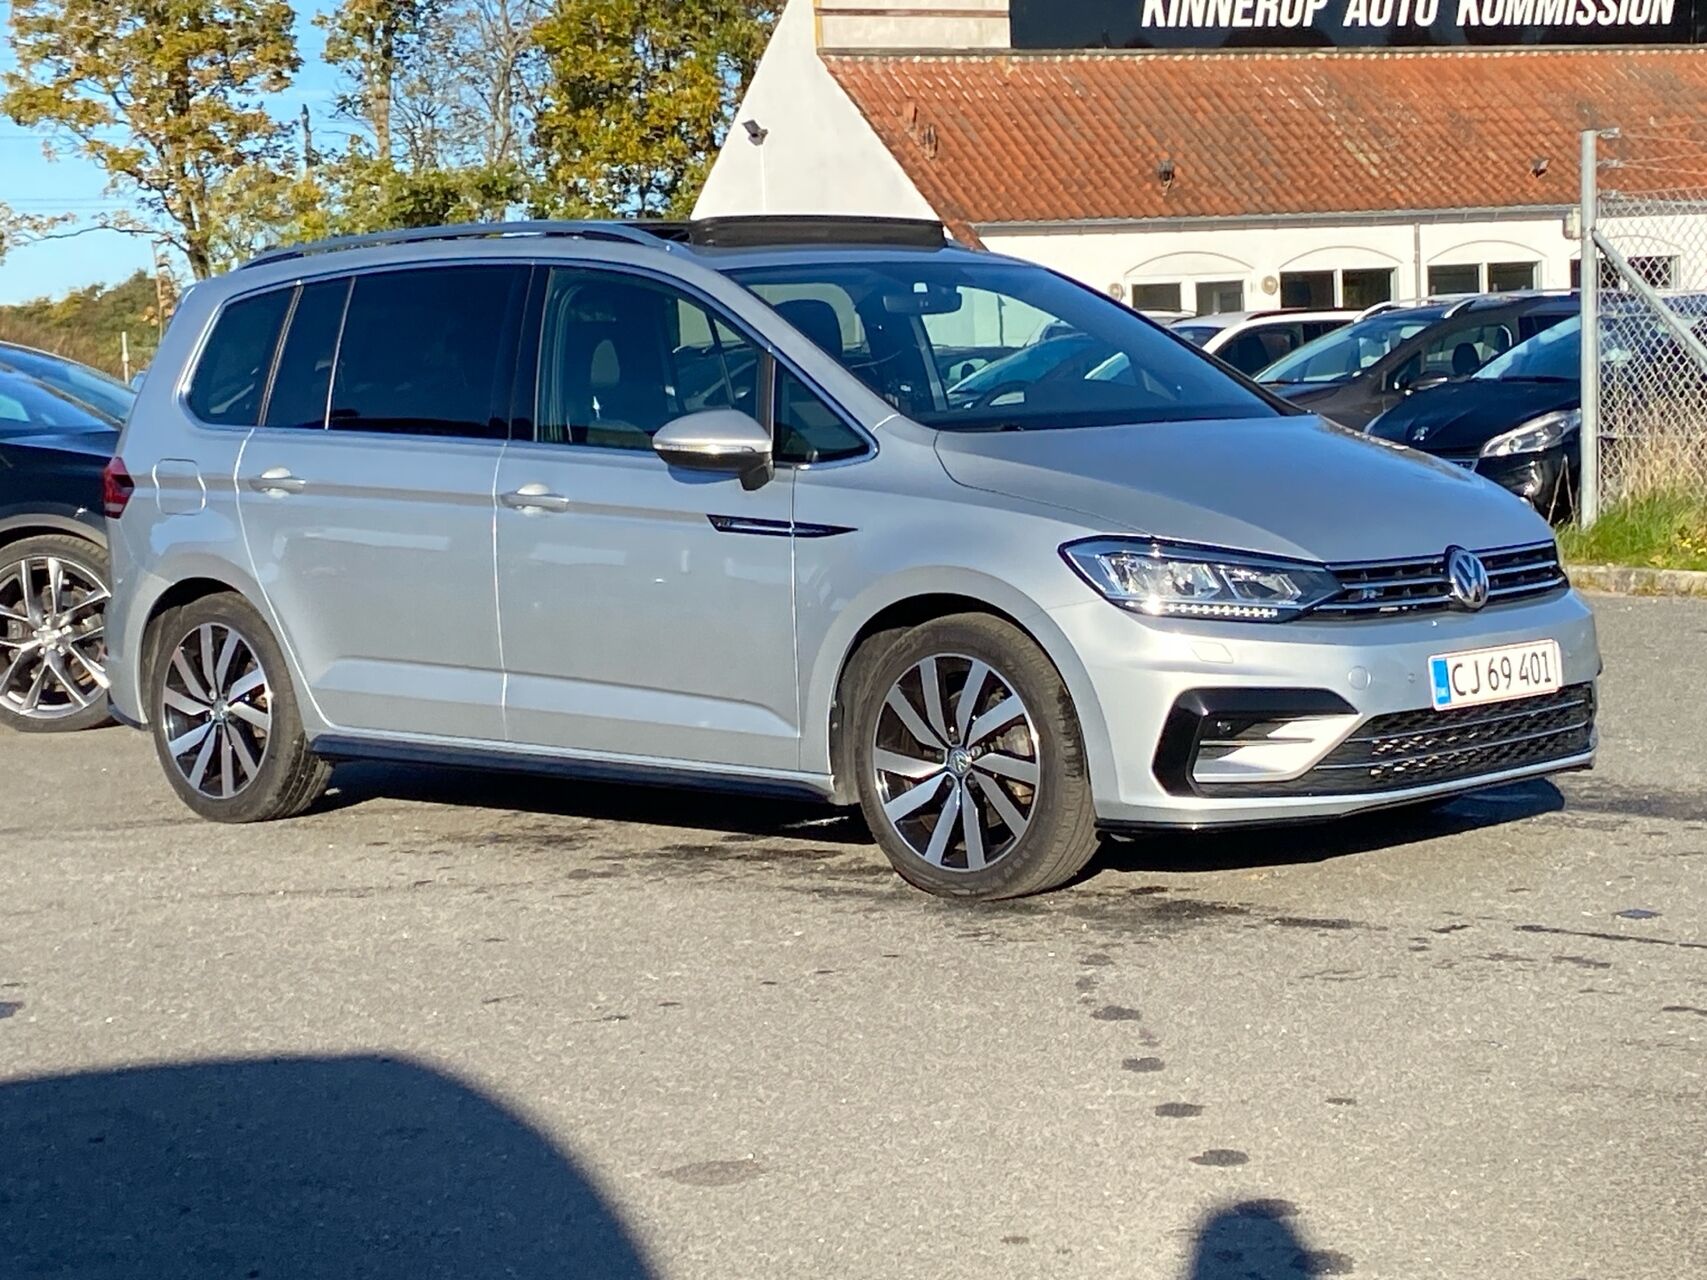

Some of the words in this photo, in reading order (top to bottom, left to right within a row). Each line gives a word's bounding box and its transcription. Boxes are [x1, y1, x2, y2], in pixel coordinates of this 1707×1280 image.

[1141, 0, 1328, 28] KINNERUP
[1342, 0, 1439, 28] AUTO
[1456, 0, 1676, 28] KOMMISSION
[1452, 660, 1480, 696] CJ
[1488, 656, 1512, 691] 69
[1519, 650, 1552, 686] 401
